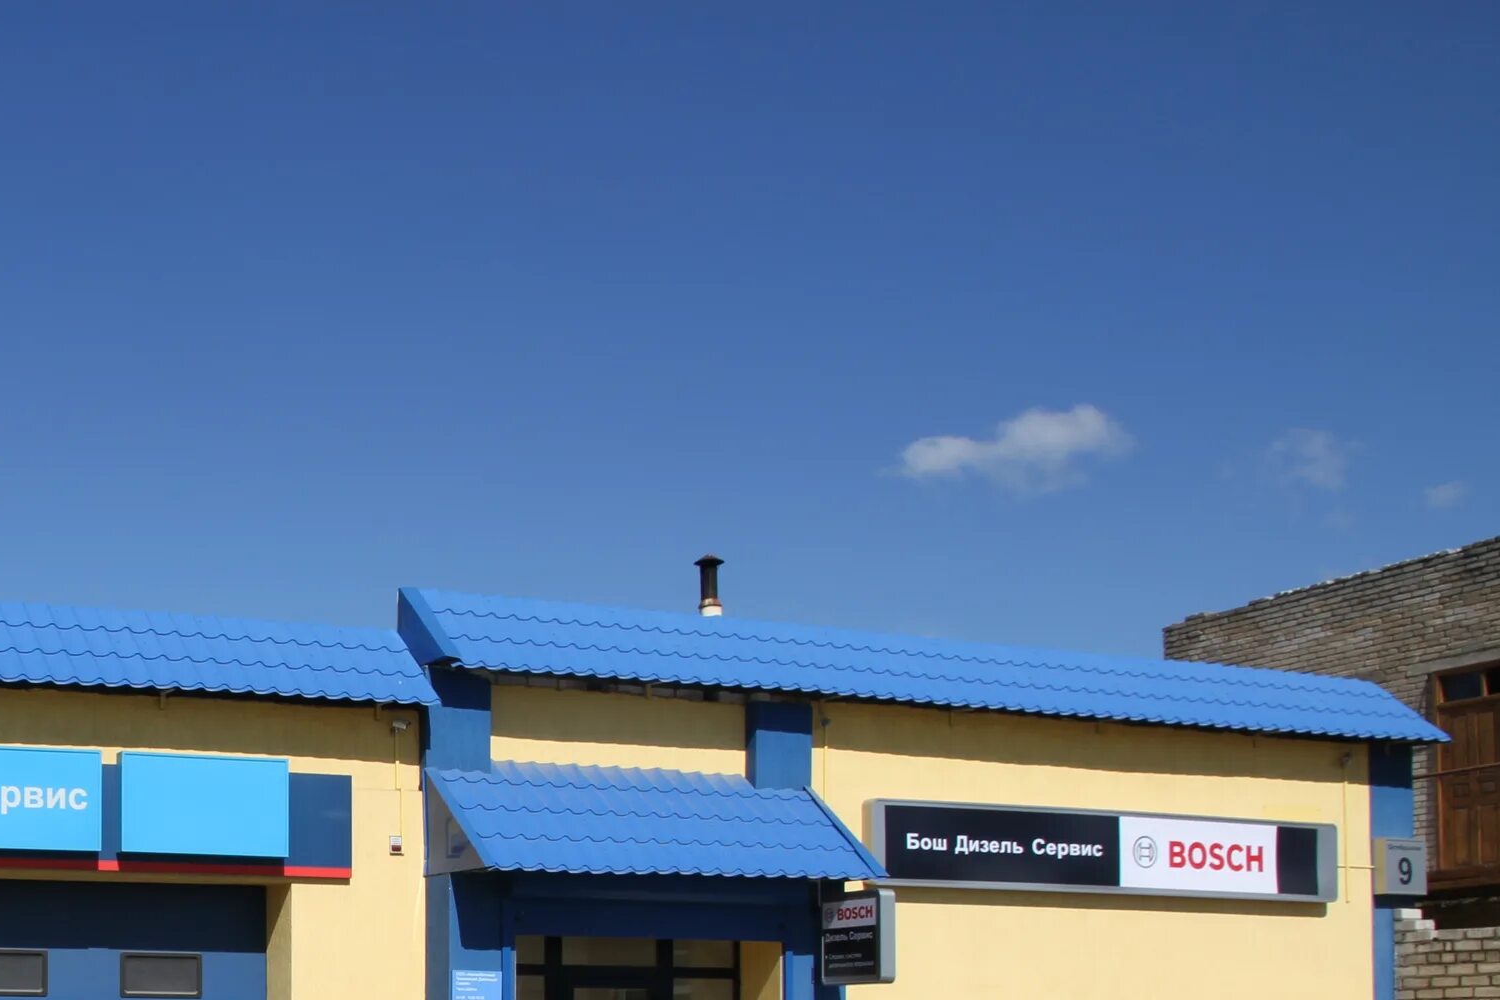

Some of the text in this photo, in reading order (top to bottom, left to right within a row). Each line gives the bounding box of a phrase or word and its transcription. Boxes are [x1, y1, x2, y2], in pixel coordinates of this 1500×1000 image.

[905, 832, 1103, 859] Бош Дизель Сервис
[1168, 840, 1264, 873] BOSCH
[1398, 857, 1412, 885] 9
[837, 905, 873, 920] BOSCH
